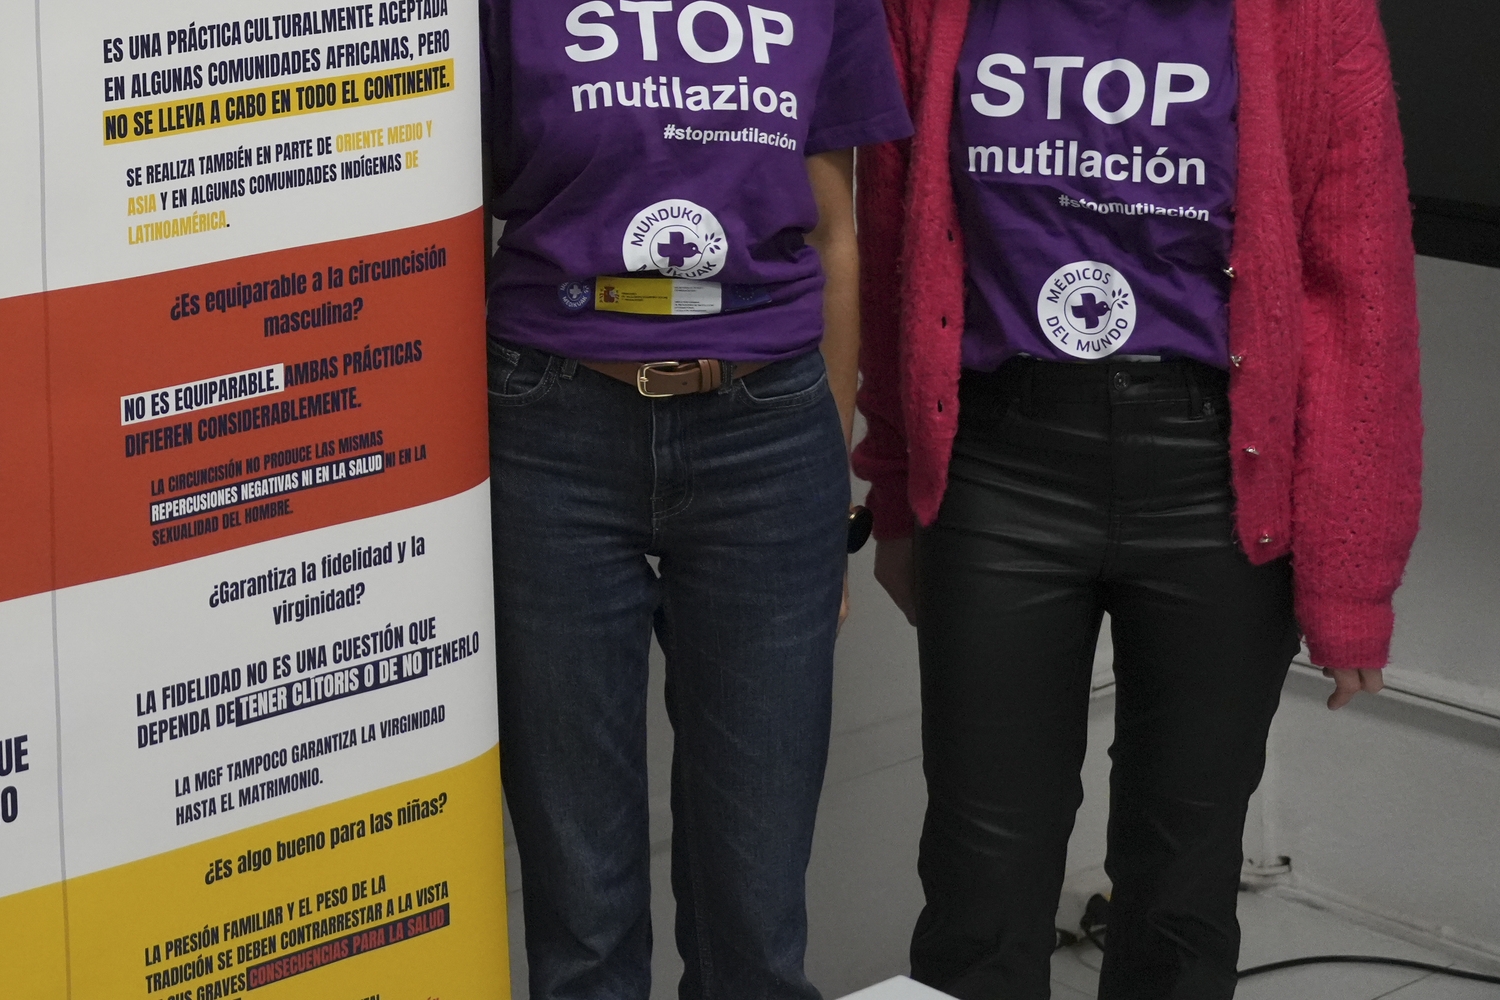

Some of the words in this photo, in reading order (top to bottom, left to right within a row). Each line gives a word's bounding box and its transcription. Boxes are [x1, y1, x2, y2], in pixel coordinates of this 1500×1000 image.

[103, 39, 123, 63] ES
[129, 33, 161, 60] UNA
[167, 22, 241, 55] PRÁCTICA
[244, 4, 373, 44] CULTURALMENTE
[564, 0, 794, 64] STOP
[104, 77, 125, 102] EN
[130, 66, 202, 98] ALGUNAS
[208, 48, 321, 86] COMUNIDADES
[326, 37, 413, 70] AFRICANAS,
[418, 29, 449, 58] PERO
[970, 53, 1210, 126] STOP
[105, 114, 127, 140] NO
[133, 109, 153, 135] SE
[158, 102, 205, 132] LLEVA
[210, 100, 221, 124] A
[225, 92, 266, 122] CABO
[271, 88, 291, 115] EN
[296, 82, 336, 111] TODO
[342, 80, 359, 103] EL
[364, 65, 450, 101] CONTINENTE.
[572, 76, 798, 120] mutilazioa
[664, 124, 796, 150] #stopmutilación
[968, 140, 1206, 185] mutilación
[128, 209, 230, 245] LATINOAMÉRICA.
[631, 206, 702, 247] MUNDUKO
[170, 293, 200, 321] ¿Es
[205, 273, 307, 313] equiparable
[312, 272, 323, 292] a
[328, 266, 343, 288] la
[349, 244, 447, 285] circuncisión
[1046, 268, 1111, 304] MÉDICOS
[263, 297, 364, 337] masculina?
[1046, 316, 1069, 345] DEL
[1076, 318, 1128, 352] MUNDO
[124, 396, 145, 422] NO
[151, 392, 170, 417] ES
[175, 369, 279, 413] EQUIPARABLE.
[284, 356, 338, 387] AMBAS
[343, 340, 422, 376] PRÁCTICAS
[125, 422, 192, 458] DIFIEREN
[198, 387, 362, 442] CONSIDERABLEMENTE.
[209, 567, 296, 608] ¿Garantiza
[301, 561, 317, 582] la
[321, 541, 392, 579] fidelidad
[398, 542, 406, 564] y
[411, 535, 425, 557] la
[273, 583, 365, 625] virginidad?
[175, 799, 217, 826] HASTA
[221, 792, 234, 813] EL
[239, 767, 323, 808] MATRIMONIO.
[204, 858, 233, 886] ¿Es
[238, 846, 272, 875] algo
[276, 830, 325, 862] bueno
[330, 815, 365, 850] para
[369, 808, 392, 835] las
[397, 792, 447, 826] niñas?
